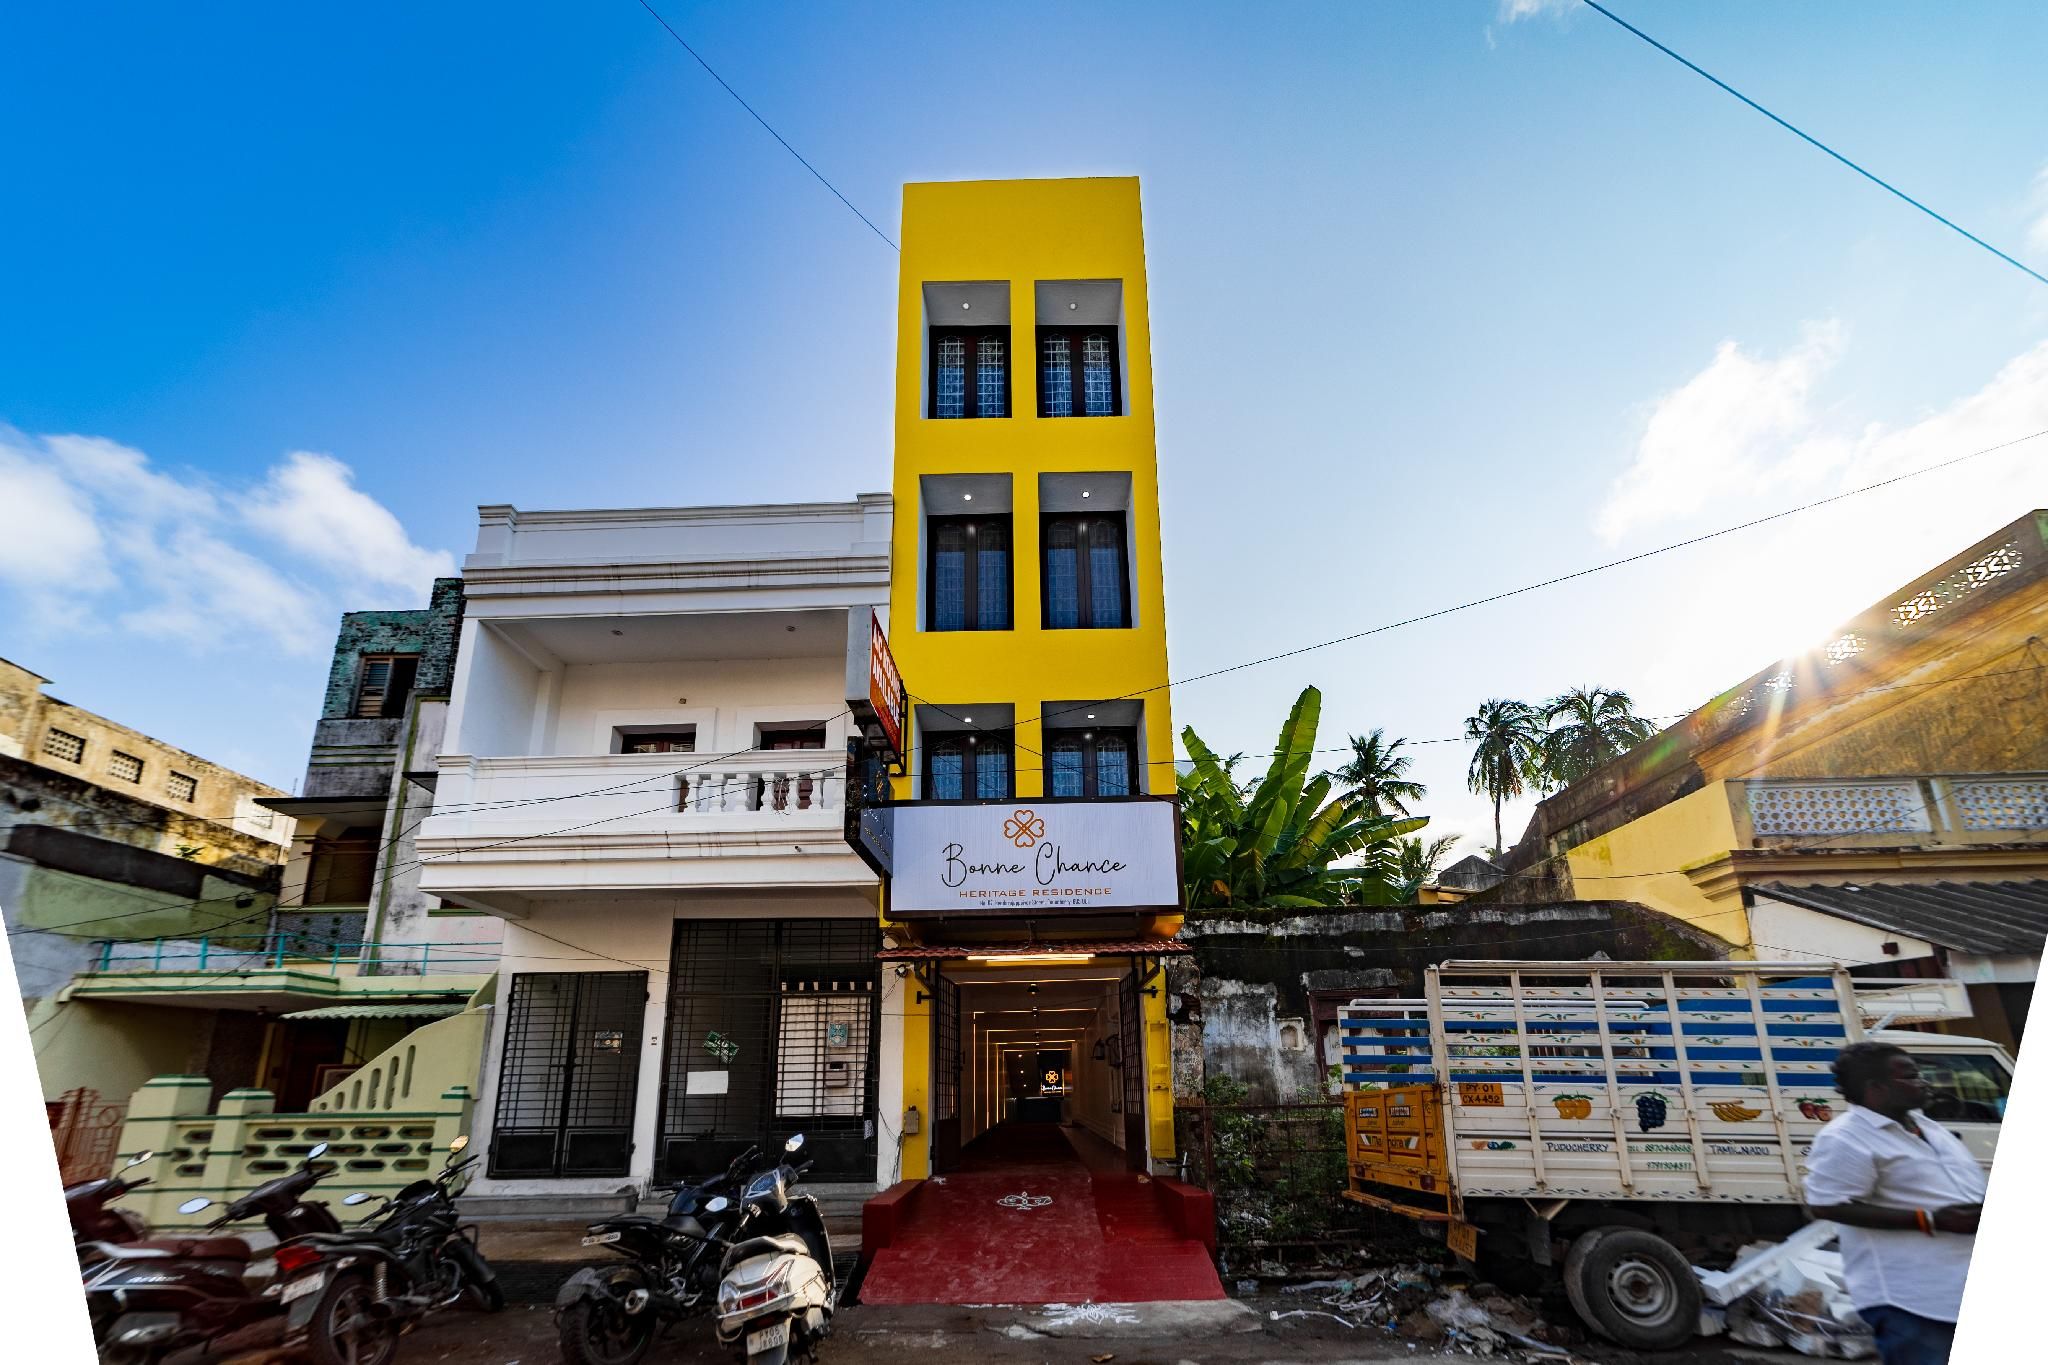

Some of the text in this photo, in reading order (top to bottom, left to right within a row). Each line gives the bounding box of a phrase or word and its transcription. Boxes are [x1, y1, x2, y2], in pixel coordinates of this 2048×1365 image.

[941, 842, 1026, 887] Bonne
[1035, 841, 1127, 885] Chance
[959, 887, 1112, 898] HERITAGE RESIDENCE
[1545, 1142, 1609, 1153] PUDUCHERRY
